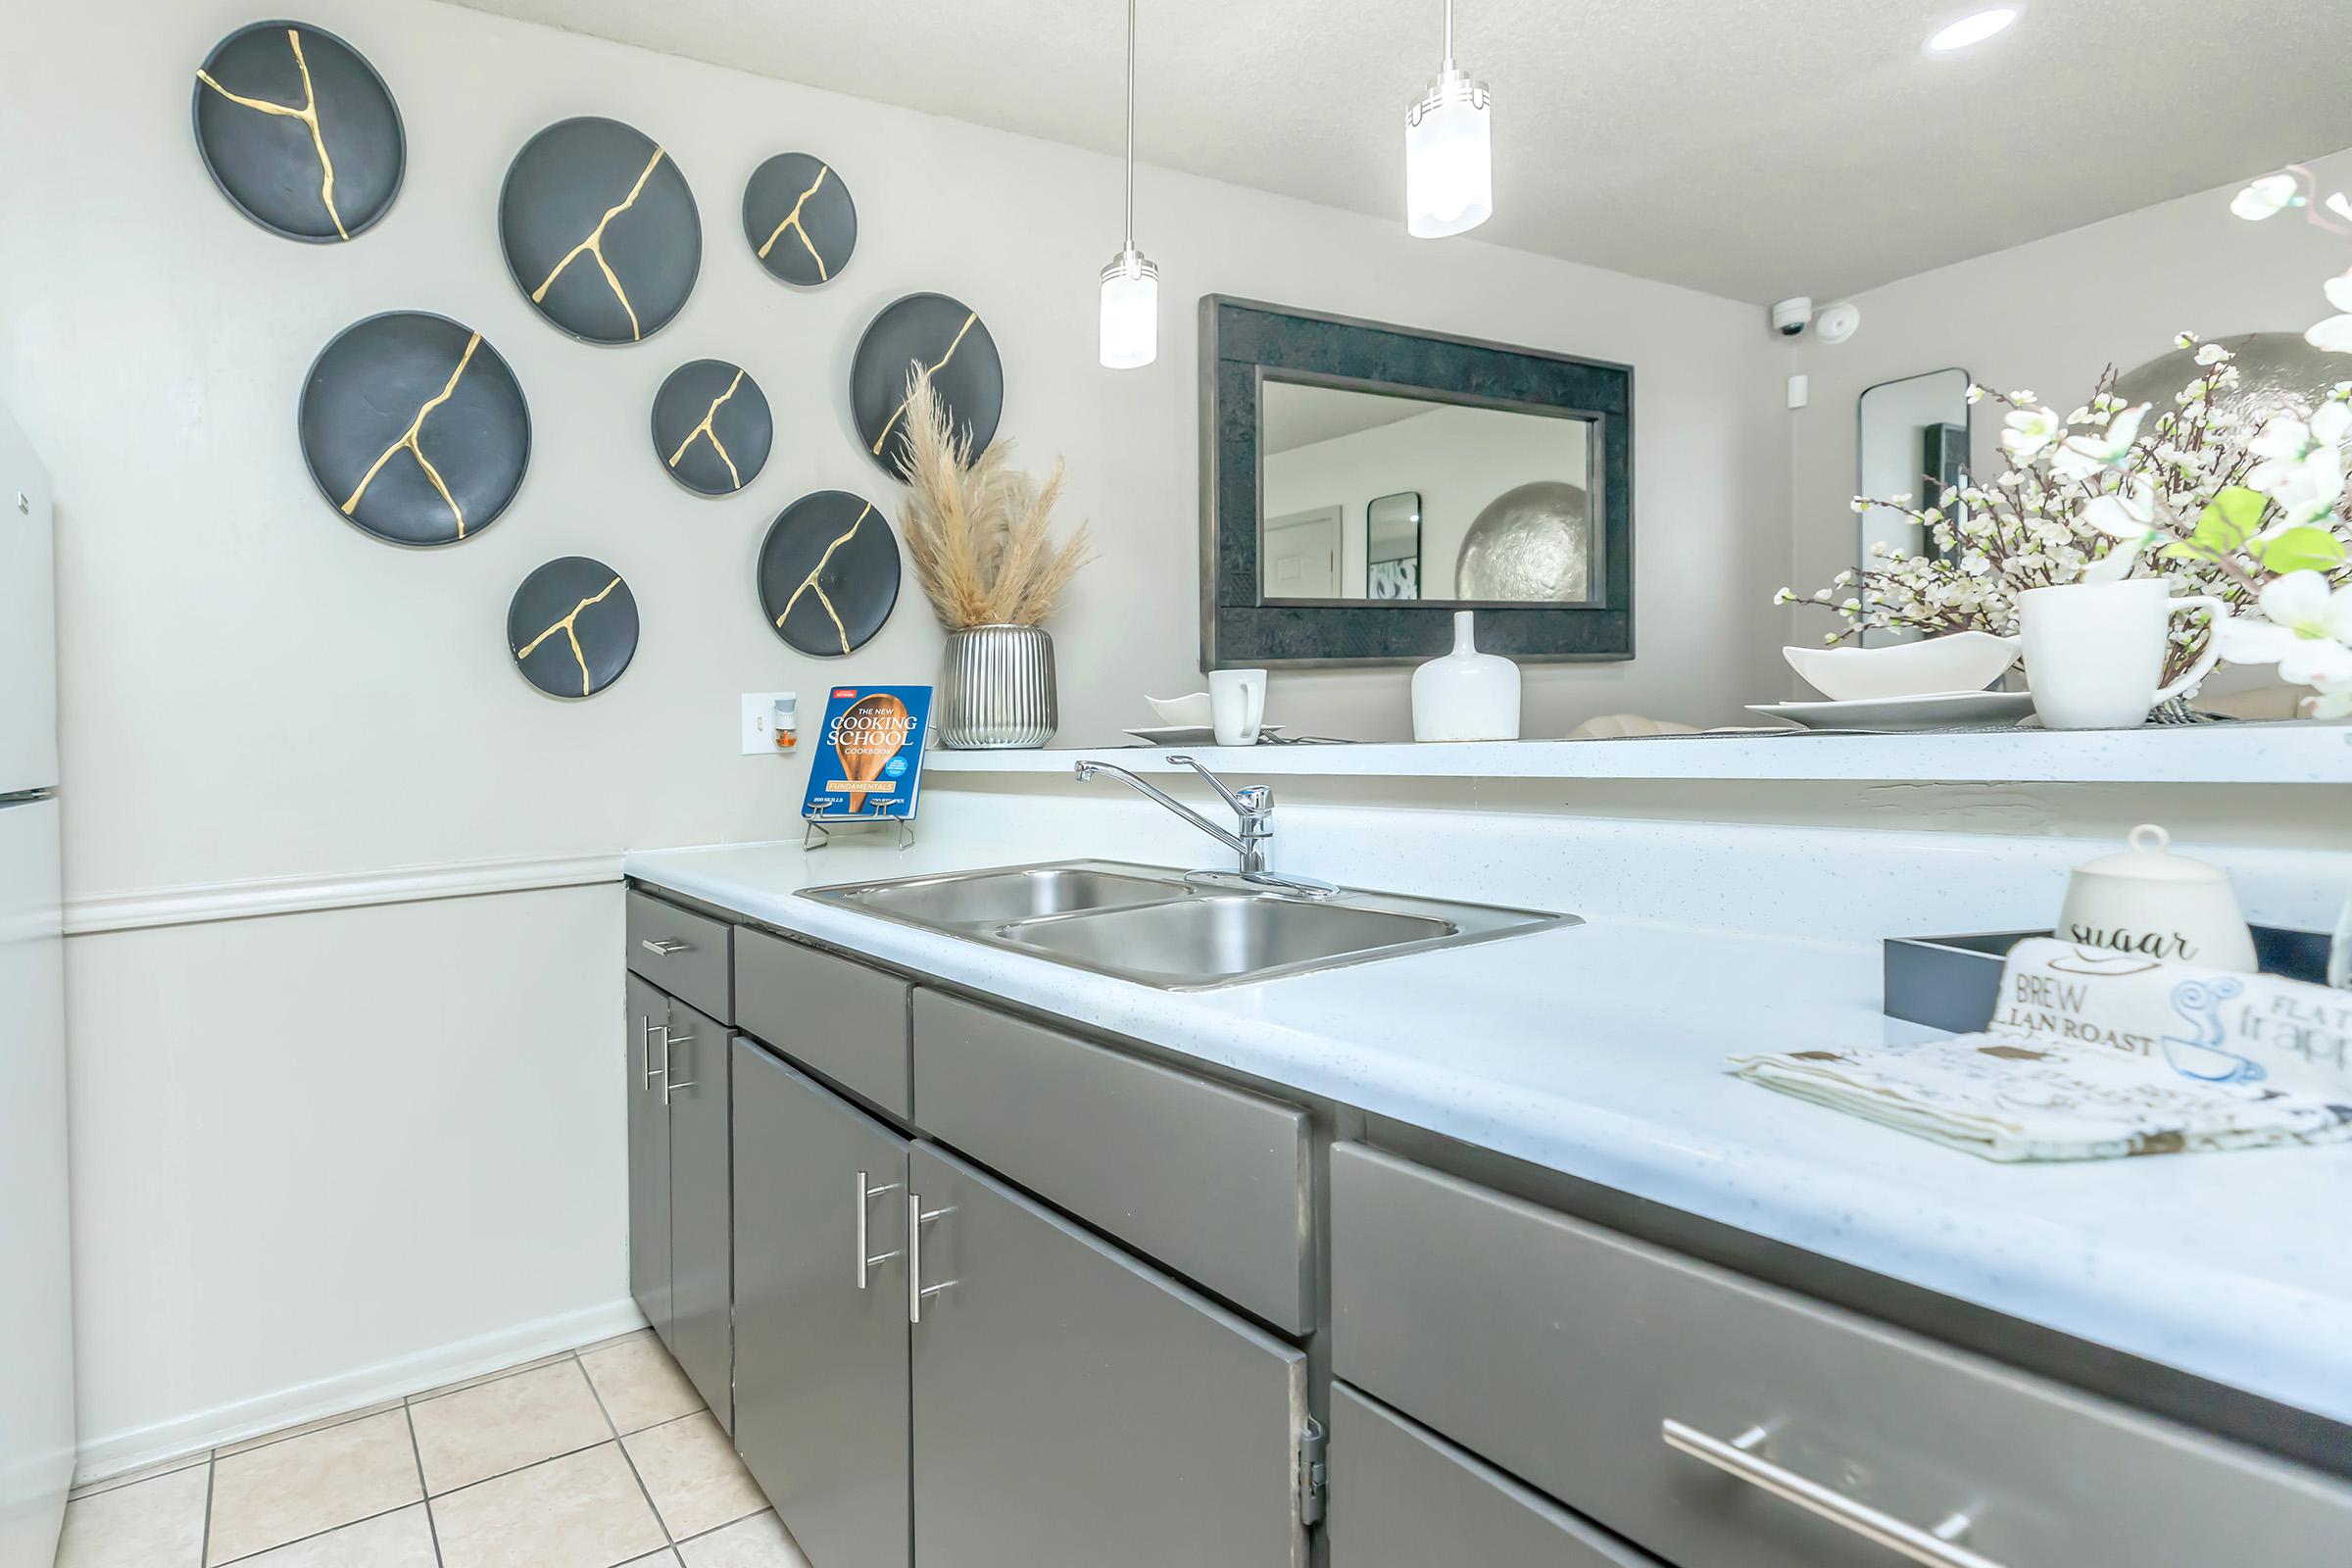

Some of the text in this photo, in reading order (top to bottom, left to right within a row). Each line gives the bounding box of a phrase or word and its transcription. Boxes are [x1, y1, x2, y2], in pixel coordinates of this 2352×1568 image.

[831, 716, 917, 730] COOKING
[827, 730, 914, 746] SCHOOL
[829, 782, 893, 791] FUNDAMENTALS
[2071, 923, 2199, 960] sugar
[2016, 973, 2087, 1013] BREW
[1995, 1007, 2155, 1056] IAN ROAST
